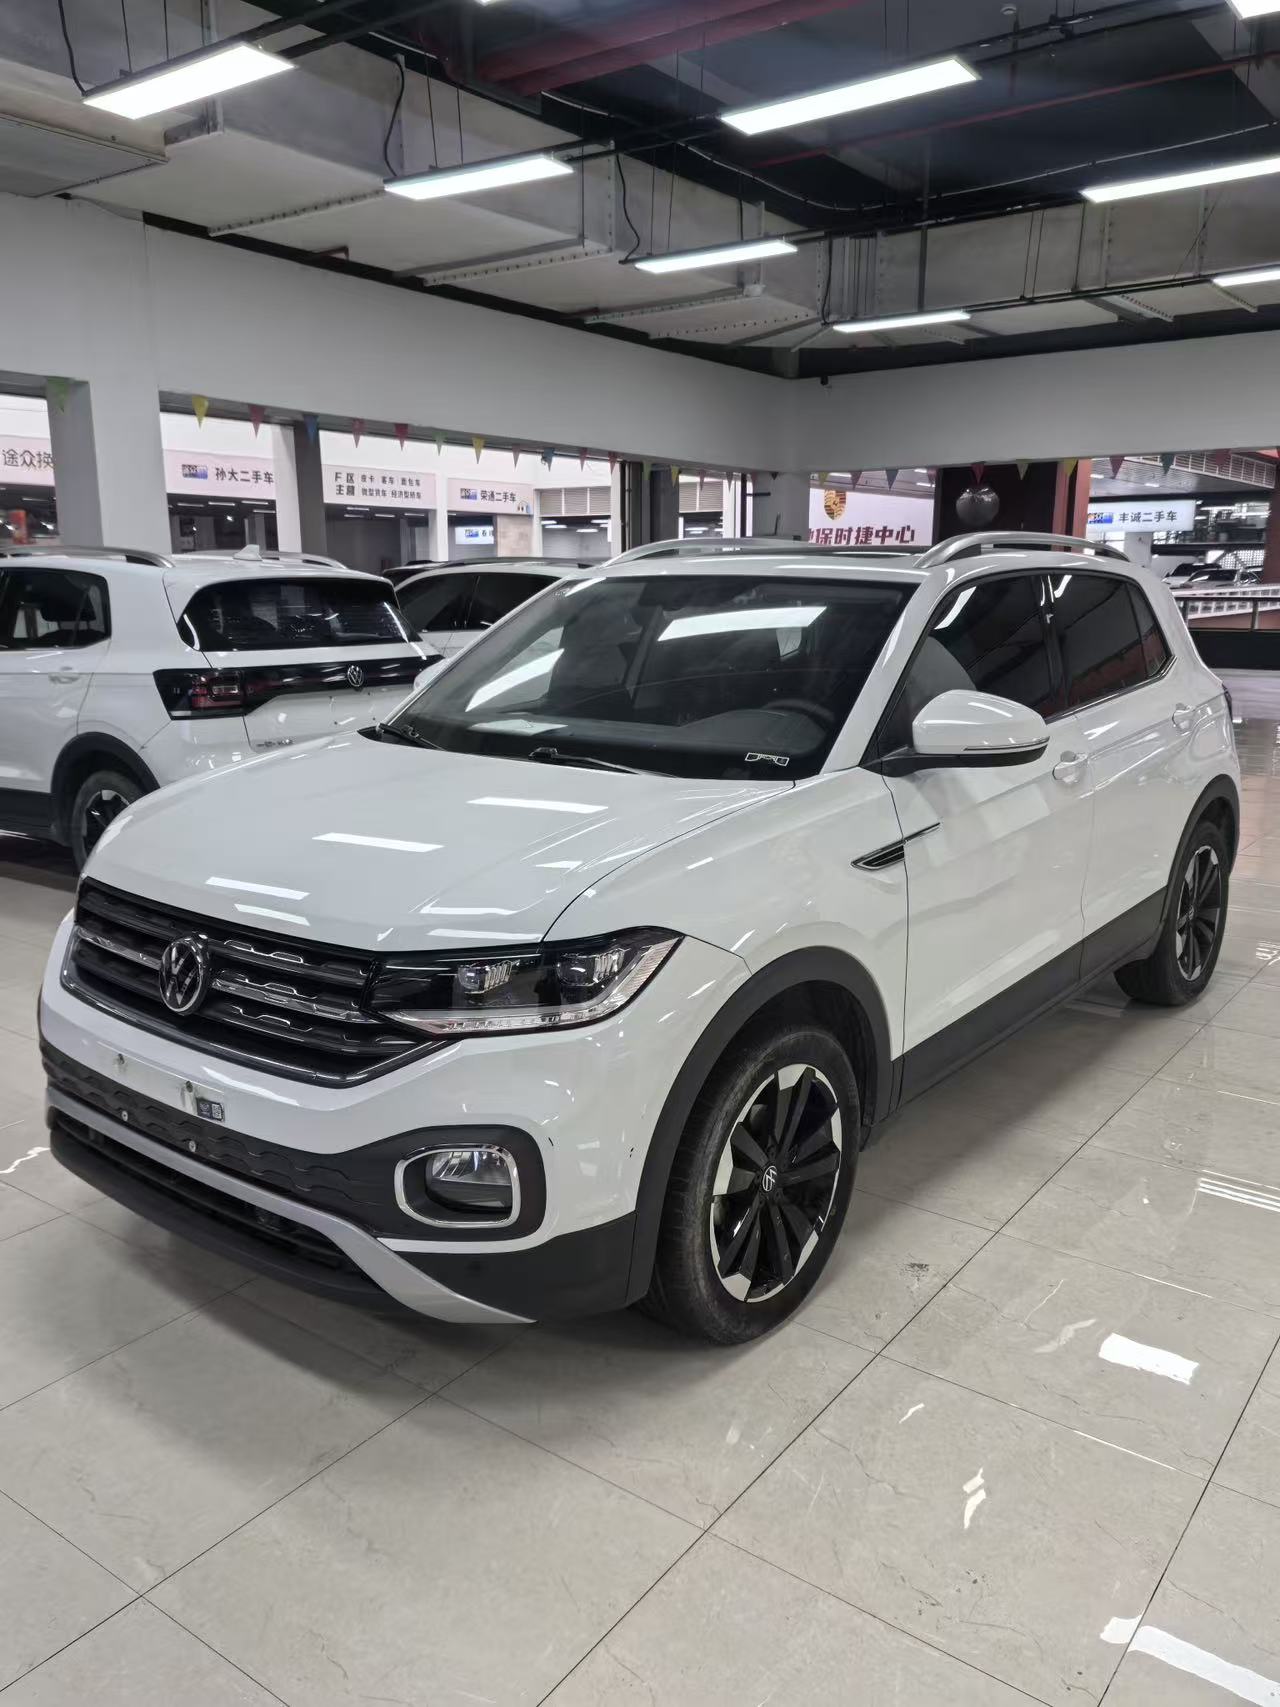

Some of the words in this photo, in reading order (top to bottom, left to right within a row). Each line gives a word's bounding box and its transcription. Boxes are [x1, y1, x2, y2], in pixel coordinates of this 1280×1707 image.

[215, 467, 274, 484] 孙大二手车
[1119, 510, 1177, 523] 丰诚二手车
